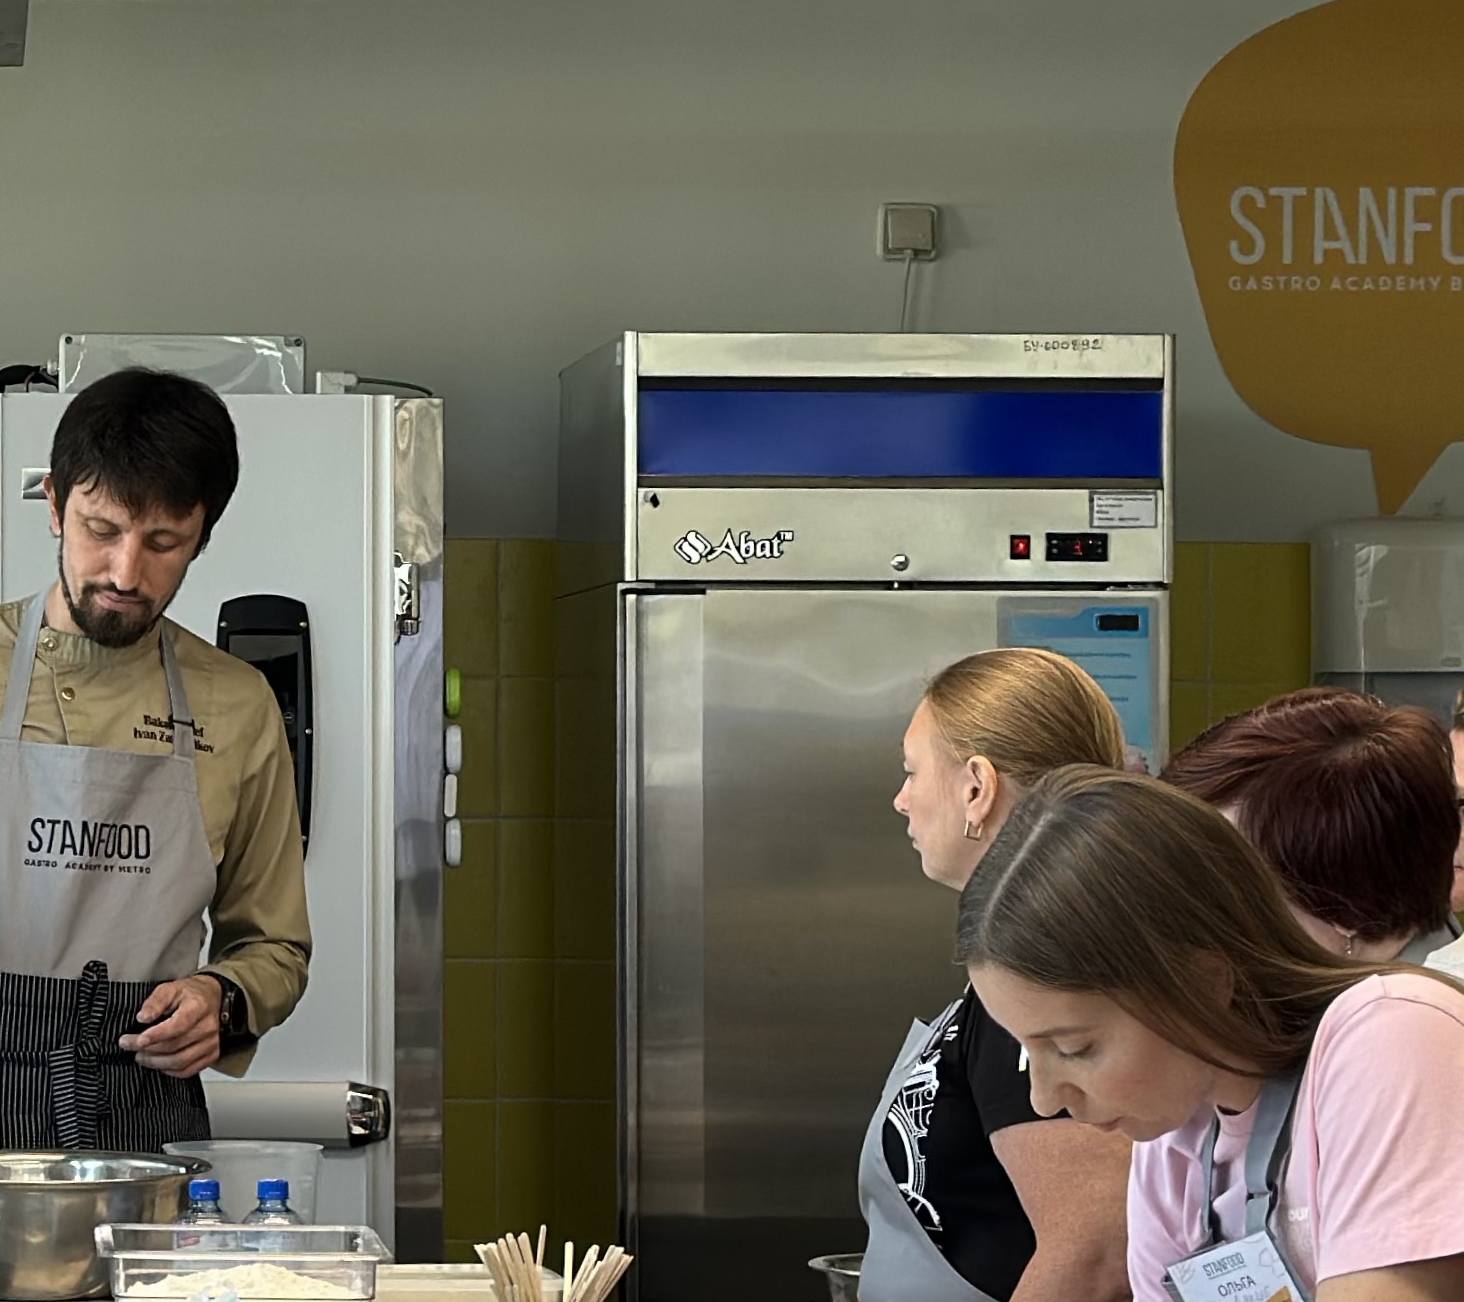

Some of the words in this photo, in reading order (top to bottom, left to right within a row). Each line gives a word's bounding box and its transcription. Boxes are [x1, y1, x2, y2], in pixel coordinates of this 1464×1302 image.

[1228, 275, 1321, 291] GASTRO
[1330, 275, 1442, 291] ACADEMY
[133, 727, 157, 740] Ivan
[27, 817, 151, 860] STANFOOD
[24, 858, 58, 868] GASTRO
[118, 865, 151, 875] METRO
[1217, 1275, 1257, 1298] ОЛЬГА
